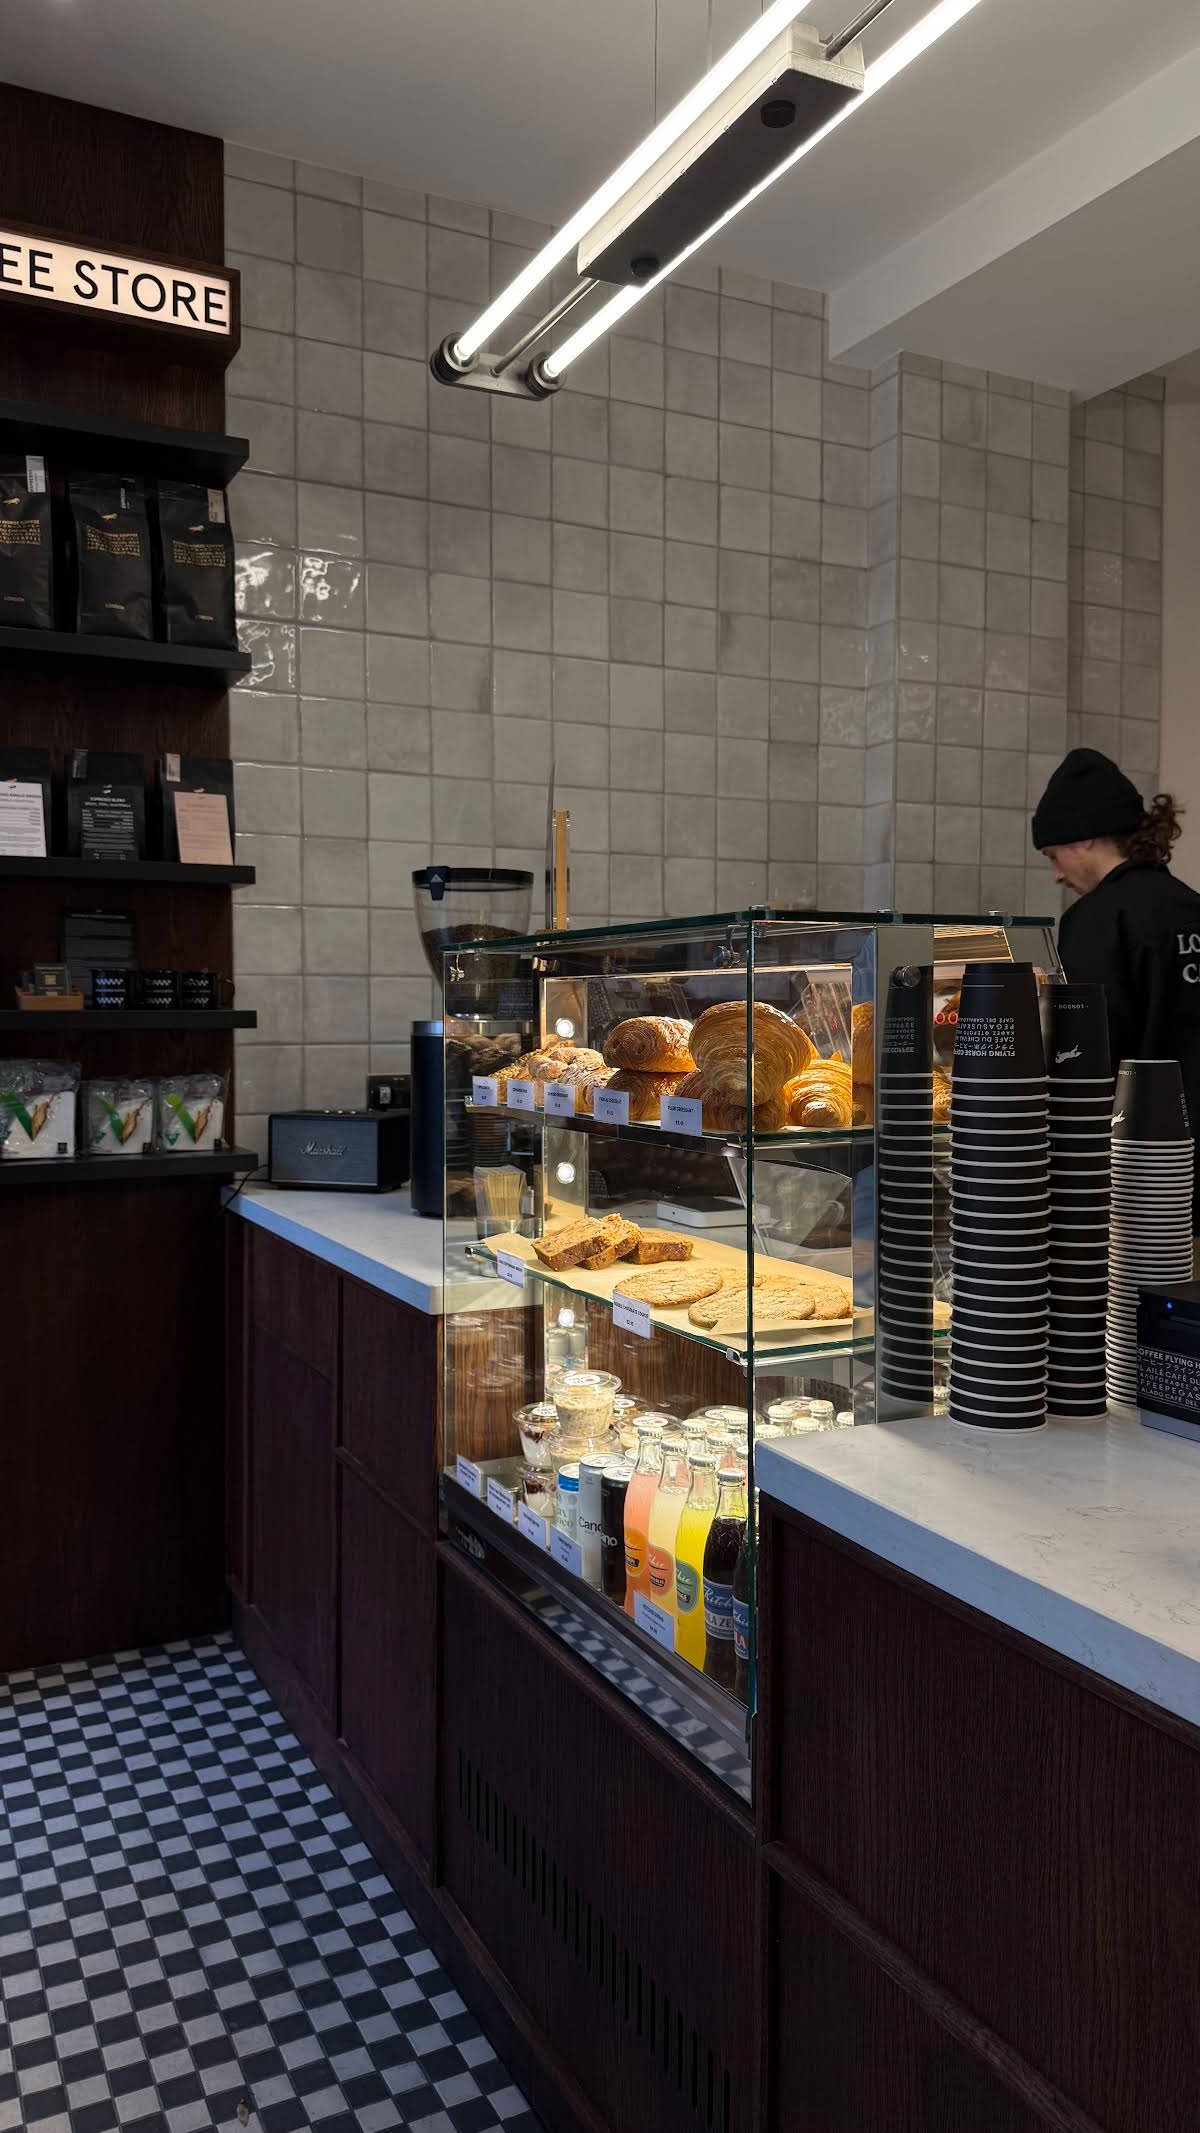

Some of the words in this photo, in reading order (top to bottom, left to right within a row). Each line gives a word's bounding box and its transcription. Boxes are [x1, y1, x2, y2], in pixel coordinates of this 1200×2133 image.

[73, 259, 228, 328] STORE
[300, 1140, 347, 1156] Marshall
[1165, 1355, 1194, 1367] FLYING
